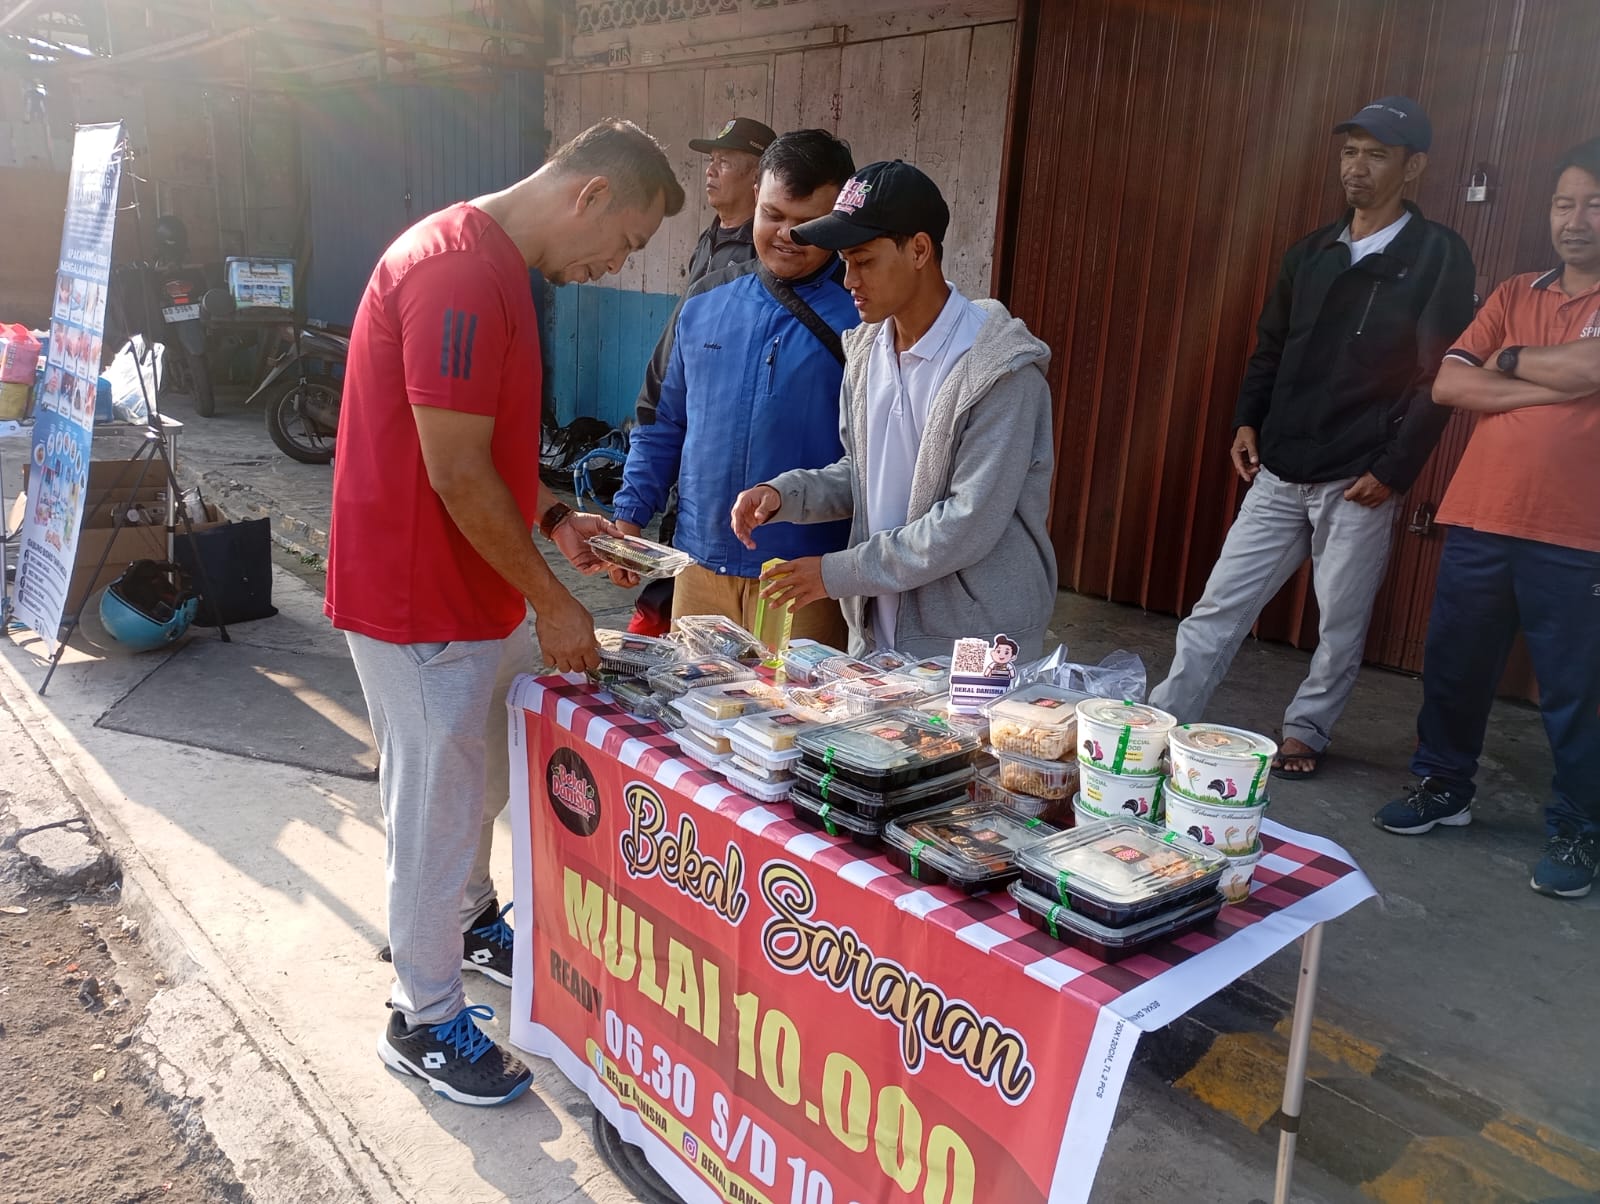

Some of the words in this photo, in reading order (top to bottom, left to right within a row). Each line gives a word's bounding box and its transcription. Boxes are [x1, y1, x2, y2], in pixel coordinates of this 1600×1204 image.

[1580, 326, 1600, 338] SPI
[953, 686, 975, 694] BEKAL
[976, 687, 1005, 696] DANISHA
[1127, 744, 1142, 752] OOD
[558, 763, 588, 798] Bekal
[620, 781, 749, 926] Bekal
[758, 859, 1036, 1106] Sarapan
[550, 948, 603, 1021] READY
[563, 866, 721, 1046] MULAI
[733, 992, 976, 1204] 10.000
[605, 1009, 695, 1118] 06.30
[711, 1092, 777, 1187] S/D
[1096, 1081, 1106, 1099] PCS
[701, 1152, 727, 1193] BEKAL
